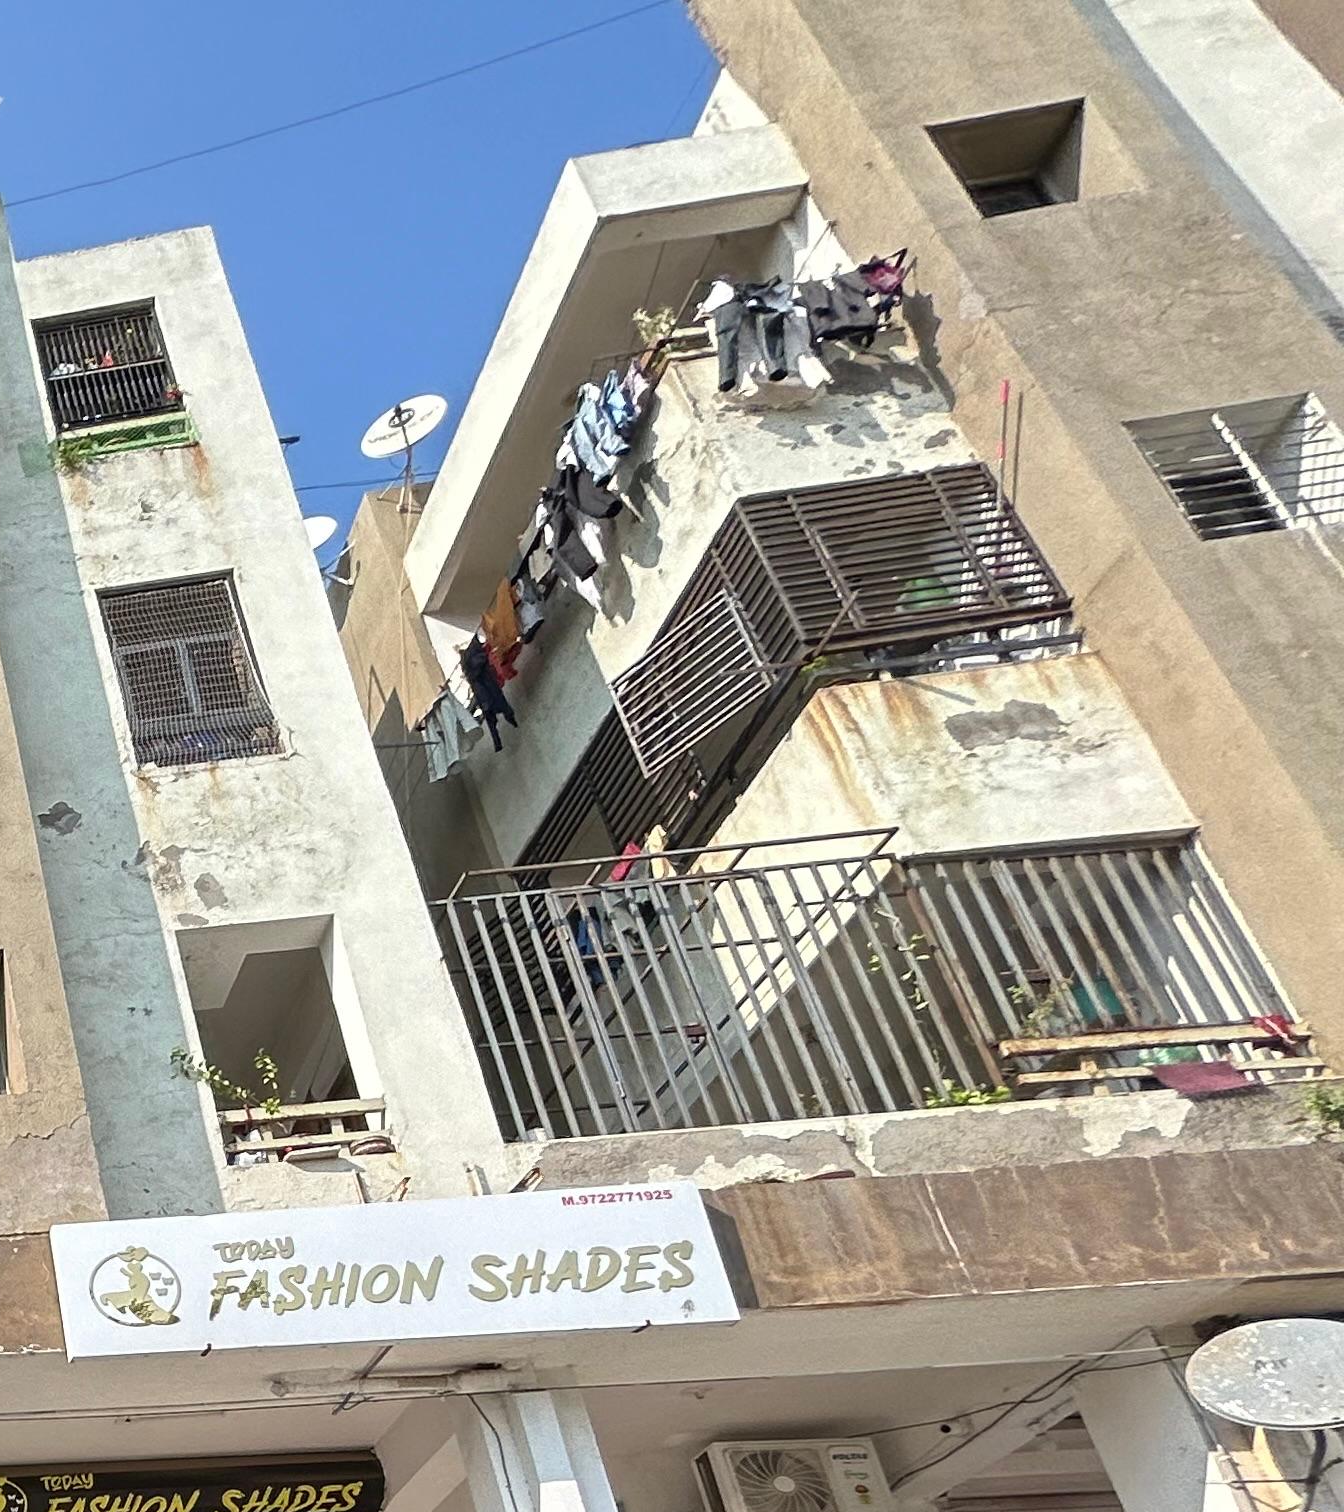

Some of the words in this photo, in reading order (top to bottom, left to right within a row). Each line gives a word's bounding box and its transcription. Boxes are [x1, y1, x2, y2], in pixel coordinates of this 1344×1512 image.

[560, 1189, 674, 1209] M.9722771925
[213, 1237, 294, 1262] TODAY
[209, 1258, 444, 1320] FASHION
[468, 1242, 695, 1303] SHADES
[39, 1472, 95, 1491] TODAY
